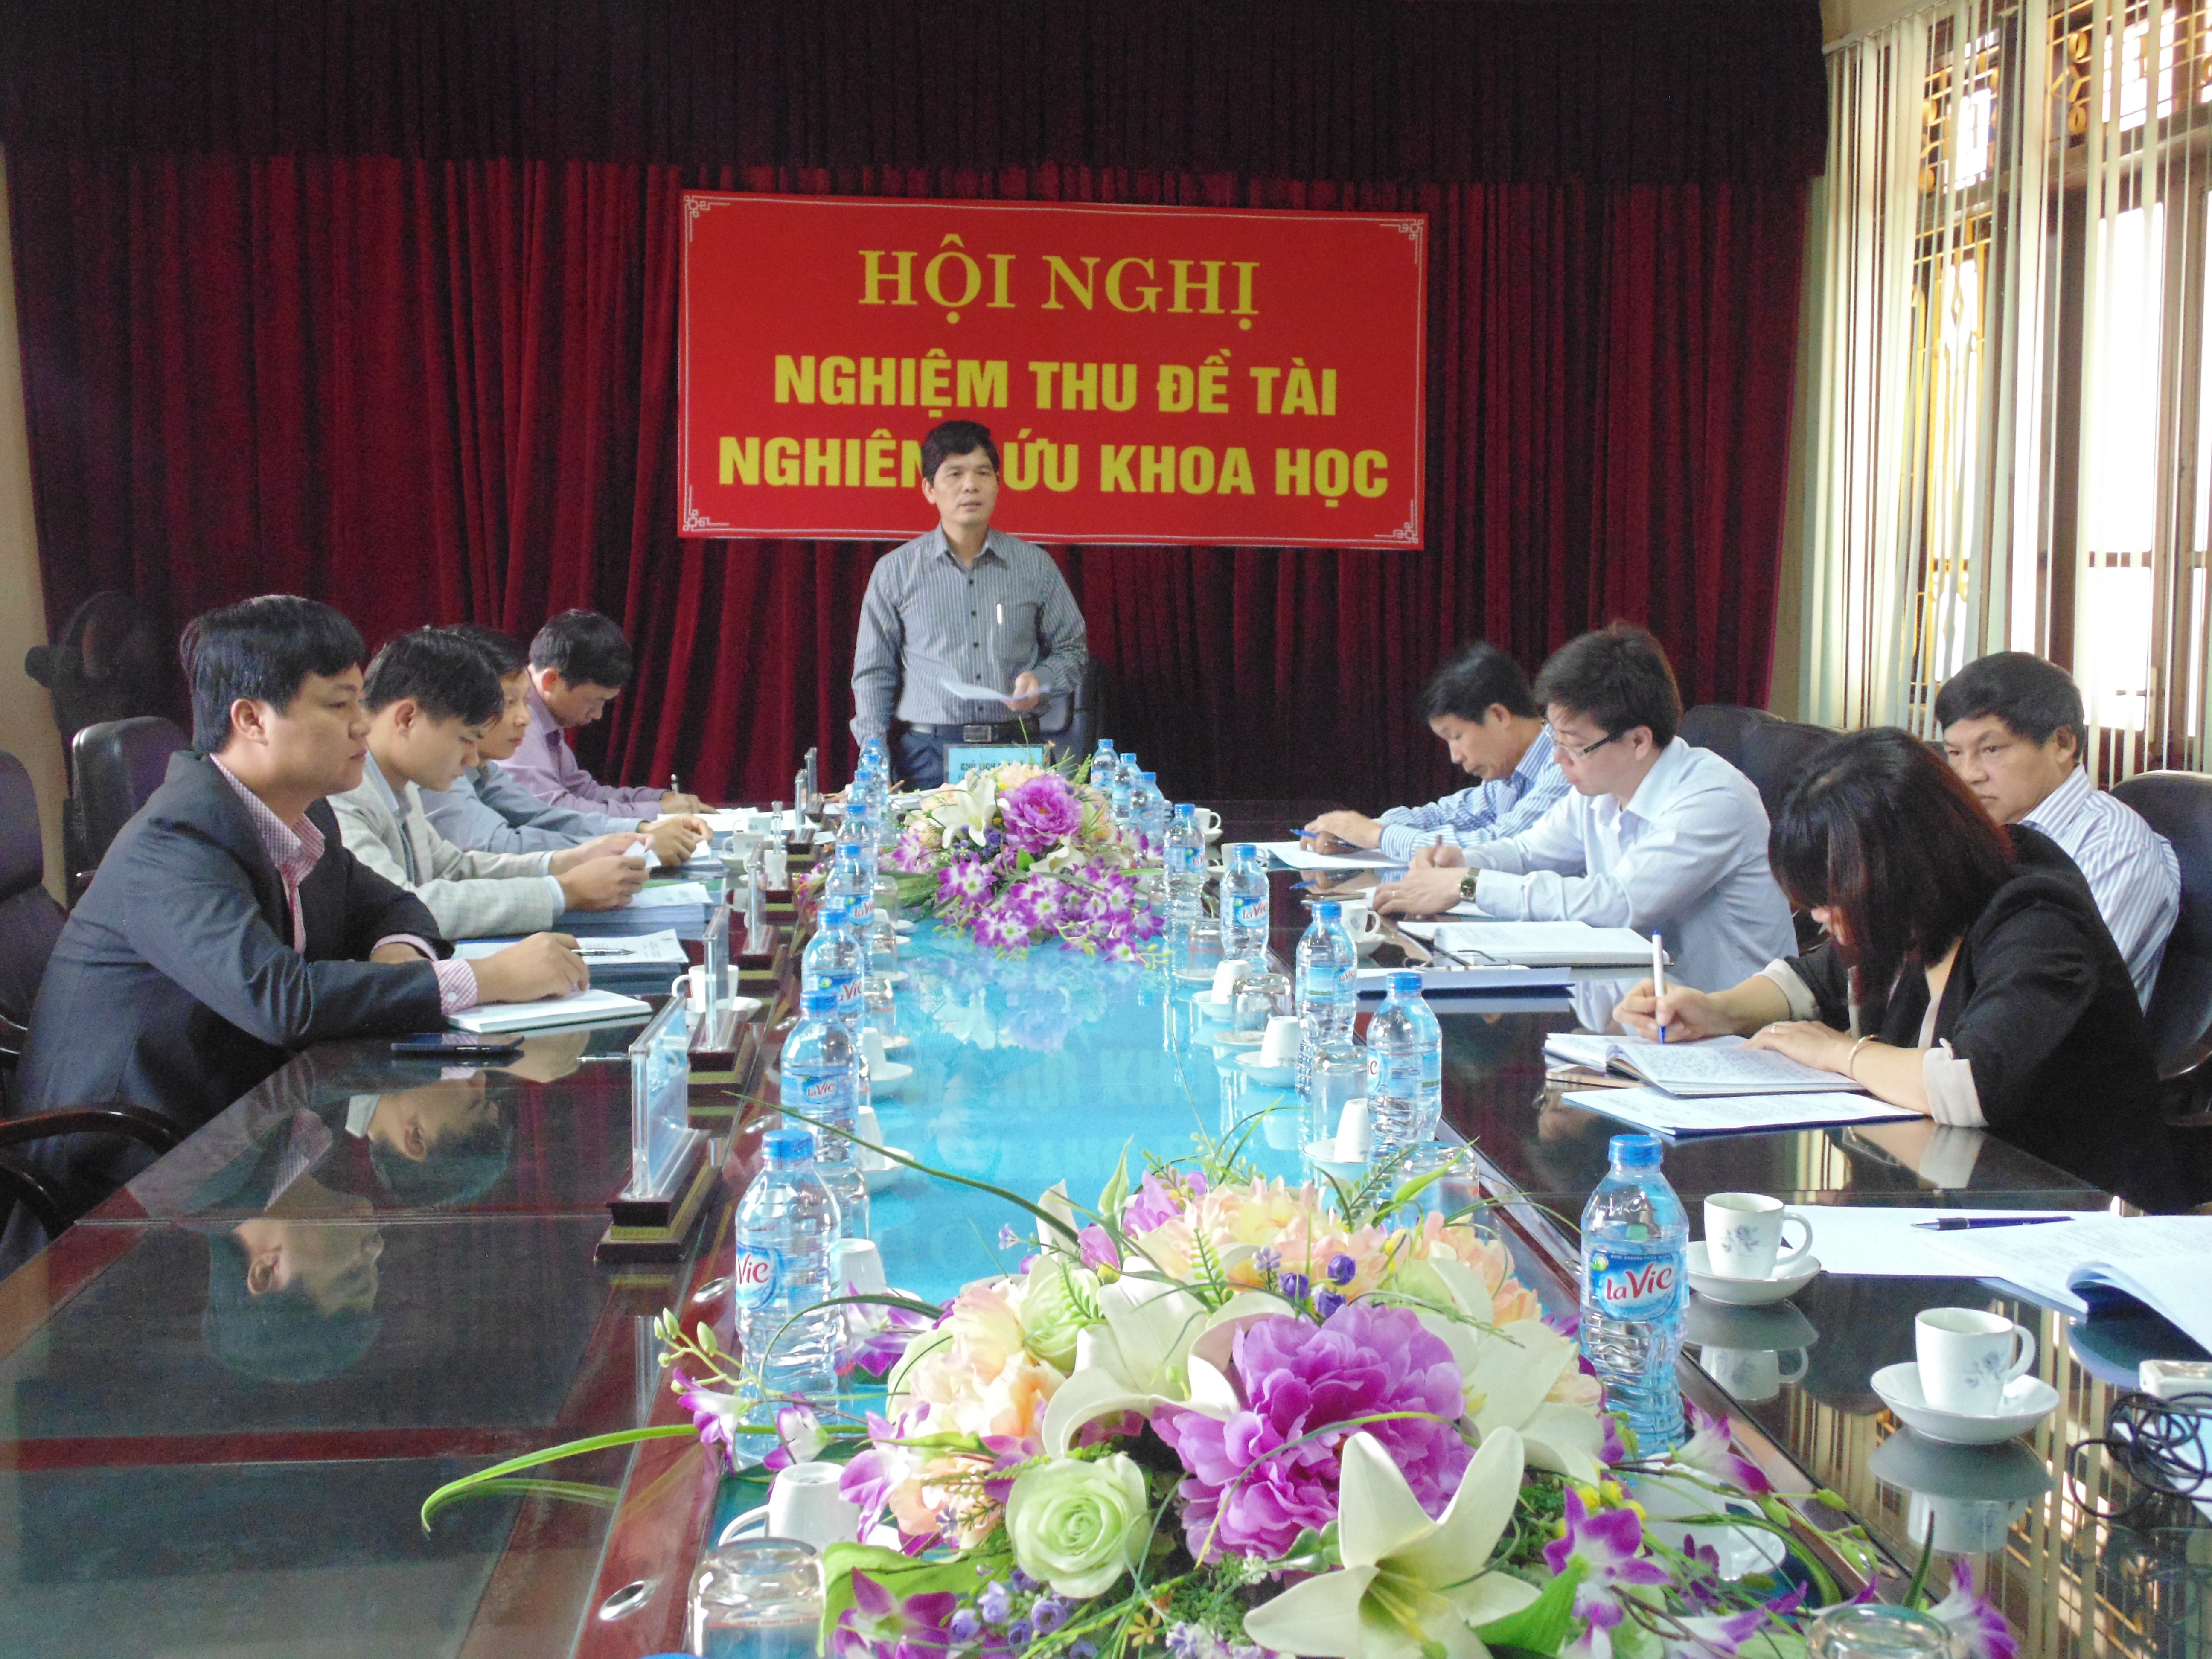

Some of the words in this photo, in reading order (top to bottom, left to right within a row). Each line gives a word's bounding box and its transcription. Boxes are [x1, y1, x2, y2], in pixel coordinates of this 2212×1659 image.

[859, 233, 1016, 323] HỘI
[1042, 256, 1260, 330] NGHỊ
[774, 348, 1008, 418] NGHIỆM
[1028, 361, 1138, 412] THU
[1156, 348, 1229, 413] ĐỀ
[1249, 357, 1337, 416] TÀI
[1003, 428, 1079, 492] ỨU
[1100, 444, 1255, 495] KHOA
[1275, 448, 1388, 507] HỌC
